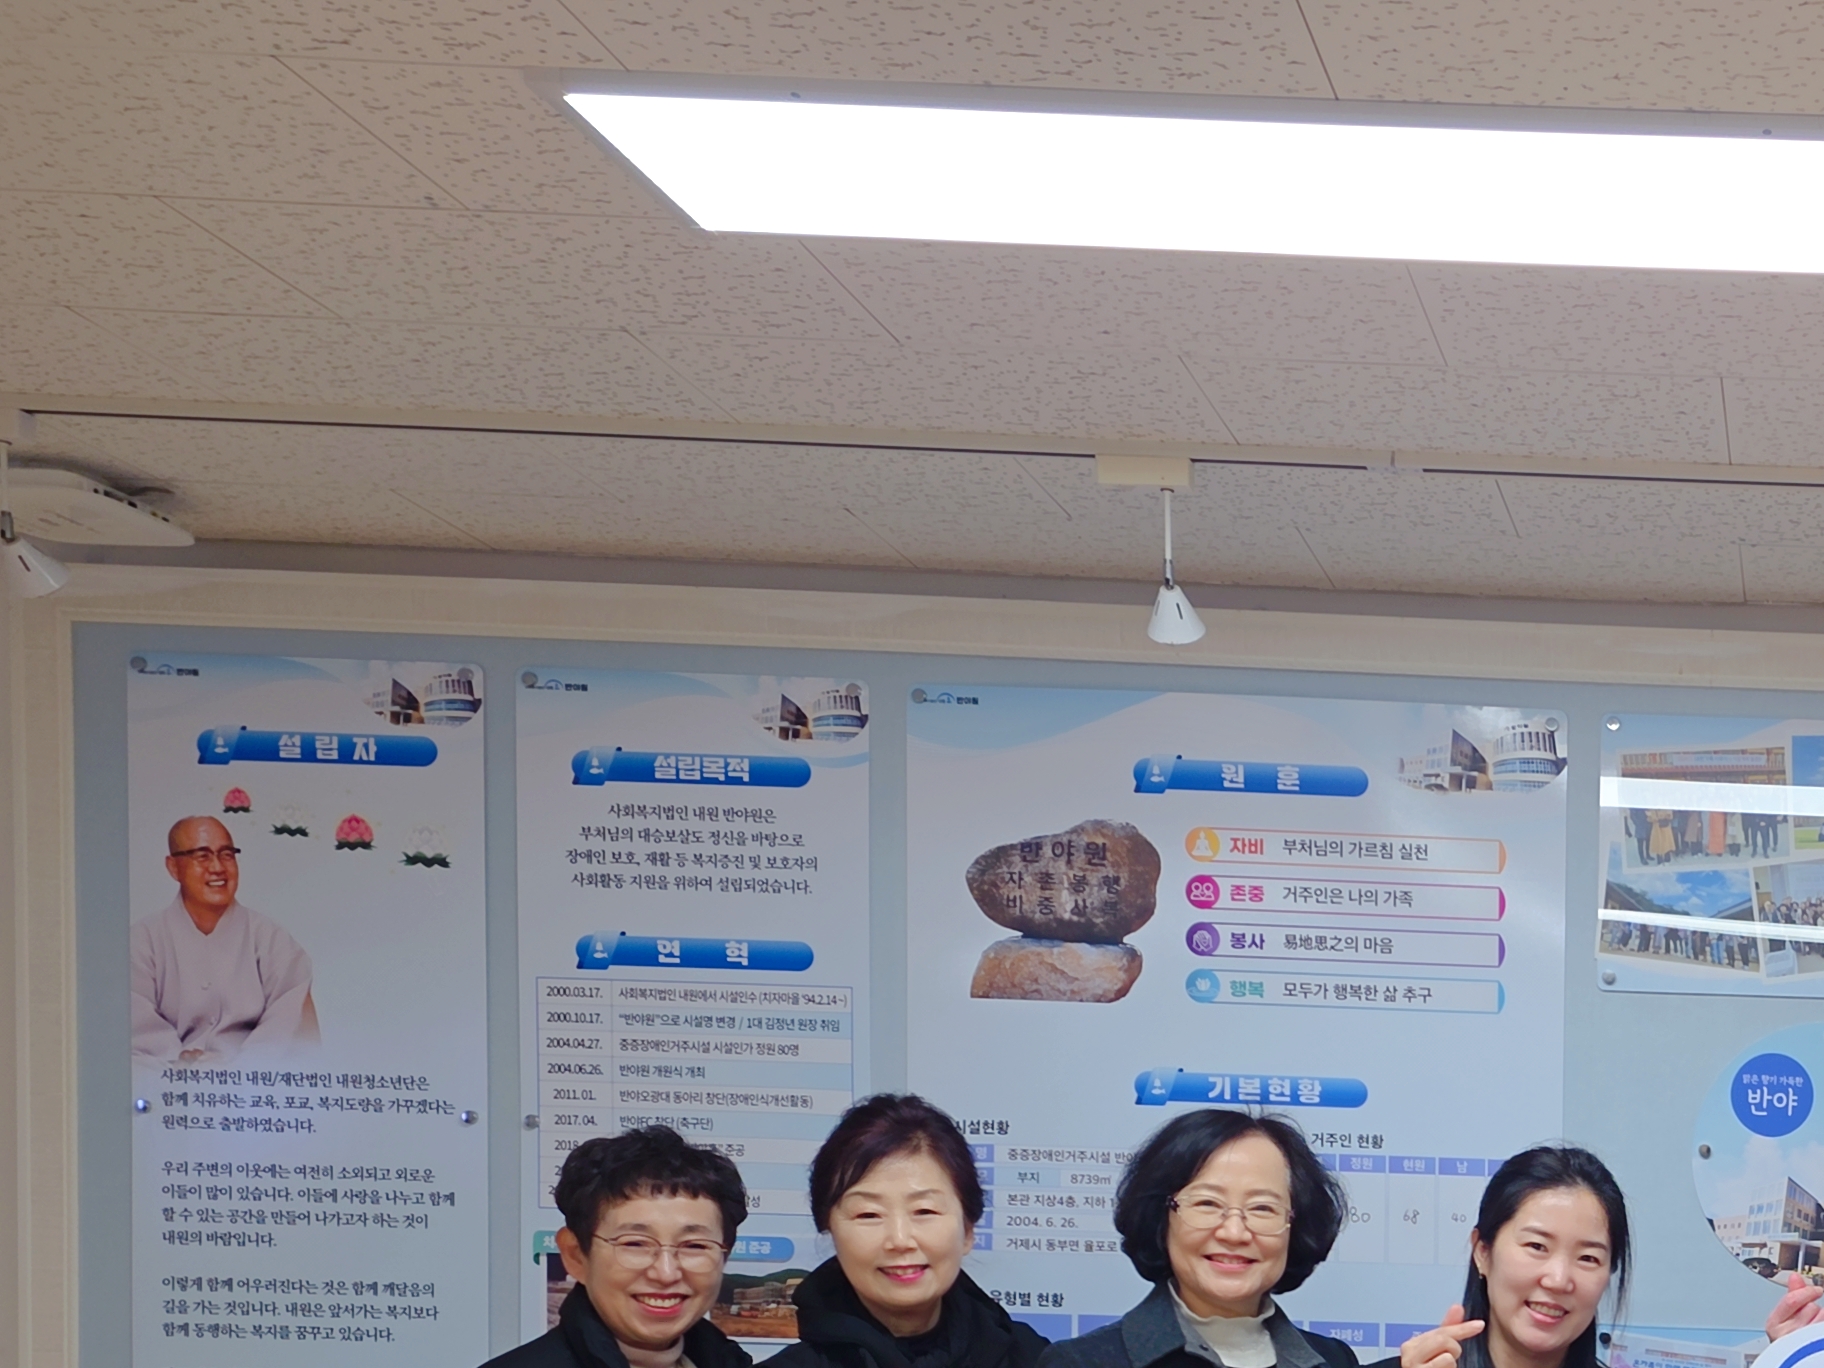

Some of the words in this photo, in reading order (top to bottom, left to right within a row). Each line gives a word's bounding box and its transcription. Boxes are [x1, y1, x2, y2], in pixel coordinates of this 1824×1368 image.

[278, 734, 377, 761] 설립자
[653, 754, 750, 782] 설립목적
[607, 803, 689, 821] 사회복지법인
[692, 806, 720, 822] 내원
[722, 807, 777, 823] 반야원은
[579, 826, 634, 842] 부처님의
[637, 827, 705, 845] 대승보살도
[708, 830, 749, 846] 정신을
[750, 831, 805, 848] 바탕으로
[1019, 838, 1107, 868] 반야원
[1230, 837, 1265, 855] 자비
[1282, 839, 1344, 858] 부처님의
[1348, 841, 1394, 859] 가르침
[1398, 843, 1429, 860] 실천
[565, 848, 607, 865] 장애인
[609, 851, 641, 866] 보호,
[644, 851, 673, 867] 재활
[674, 853, 689, 868] 등
[690, 853, 745, 869] 복지증진
[748, 854, 762, 870] 및
[764, 855, 818, 871] 보호자의
[571, 872, 627, 889] 사회활동
[629, 874, 671, 890] 지원을
[672, 875, 713, 892] 위하여
[716, 877, 813, 895] 설립되었습니다.
[1230, 884, 1265, 903] 존중
[1282, 886, 1345, 905] 거주인은
[1348, 888, 1379, 906] 나의
[1383, 890, 1414, 908] 가족
[1230, 932, 1265, 950] 봉사
[1363, 937, 1394, 954] 마음
[546, 986, 604, 999] 2000.03.17.
[618, 987, 677, 1002] 사회복지법인
[679, 989, 717, 1003] 내원에서
[719, 990, 757, 1003] 시설인수
[1229, 979, 1265, 998] 행복
[1282, 982, 1329, 1000] 모두가
[1332, 984, 1379, 1001] 행복한
[1382, 985, 1399, 1002] 삶
[1402, 987, 1433, 1003] 추구
[161, 1068, 242, 1085] 사회복지법인
[245, 1071, 332, 1088] 내원/재단법인
[335, 1073, 431, 1091] 내원청소년단은
[1207, 1075, 1322, 1104] 기본현황
[161, 1091, 189, 1107] 함께
[192, 1092, 247, 1109] 치유하는
[388, 1098, 456, 1115] 가꾸겠다는
[1748, 1086, 1798, 1117] 반야
[161, 1114, 216, 1130] 원력으로
[218, 1116, 317, 1134] 출발하였습니다.
[955, 1119, 1010, 1135] 시설현황
[1311, 1133, 1352, 1148] 거주인
[1357, 1134, 1384, 1149] 현황
[1007, 1148, 1111, 1164] 중증장애인거주시설
[1350, 1157, 1373, 1170] 정원
[1403, 1159, 1426, 1172] 현원
[1456, 1161, 1468, 1173] 남
[1017, 1171, 1040, 1184] 부지
[1007, 1193, 1030, 1206] 본관
[1083, 1195, 1106, 1209] 지하
[1403, 1209, 1420, 1224] 68
[1451, 1212, 1467, 1223] 40
[1006, 1237, 1041, 1251] 거제시
[1045, 1239, 1080, 1252] 동부면
[1083, 1240, 1117, 1253] 율포로
[1036, 1292, 1064, 1308] 현황
